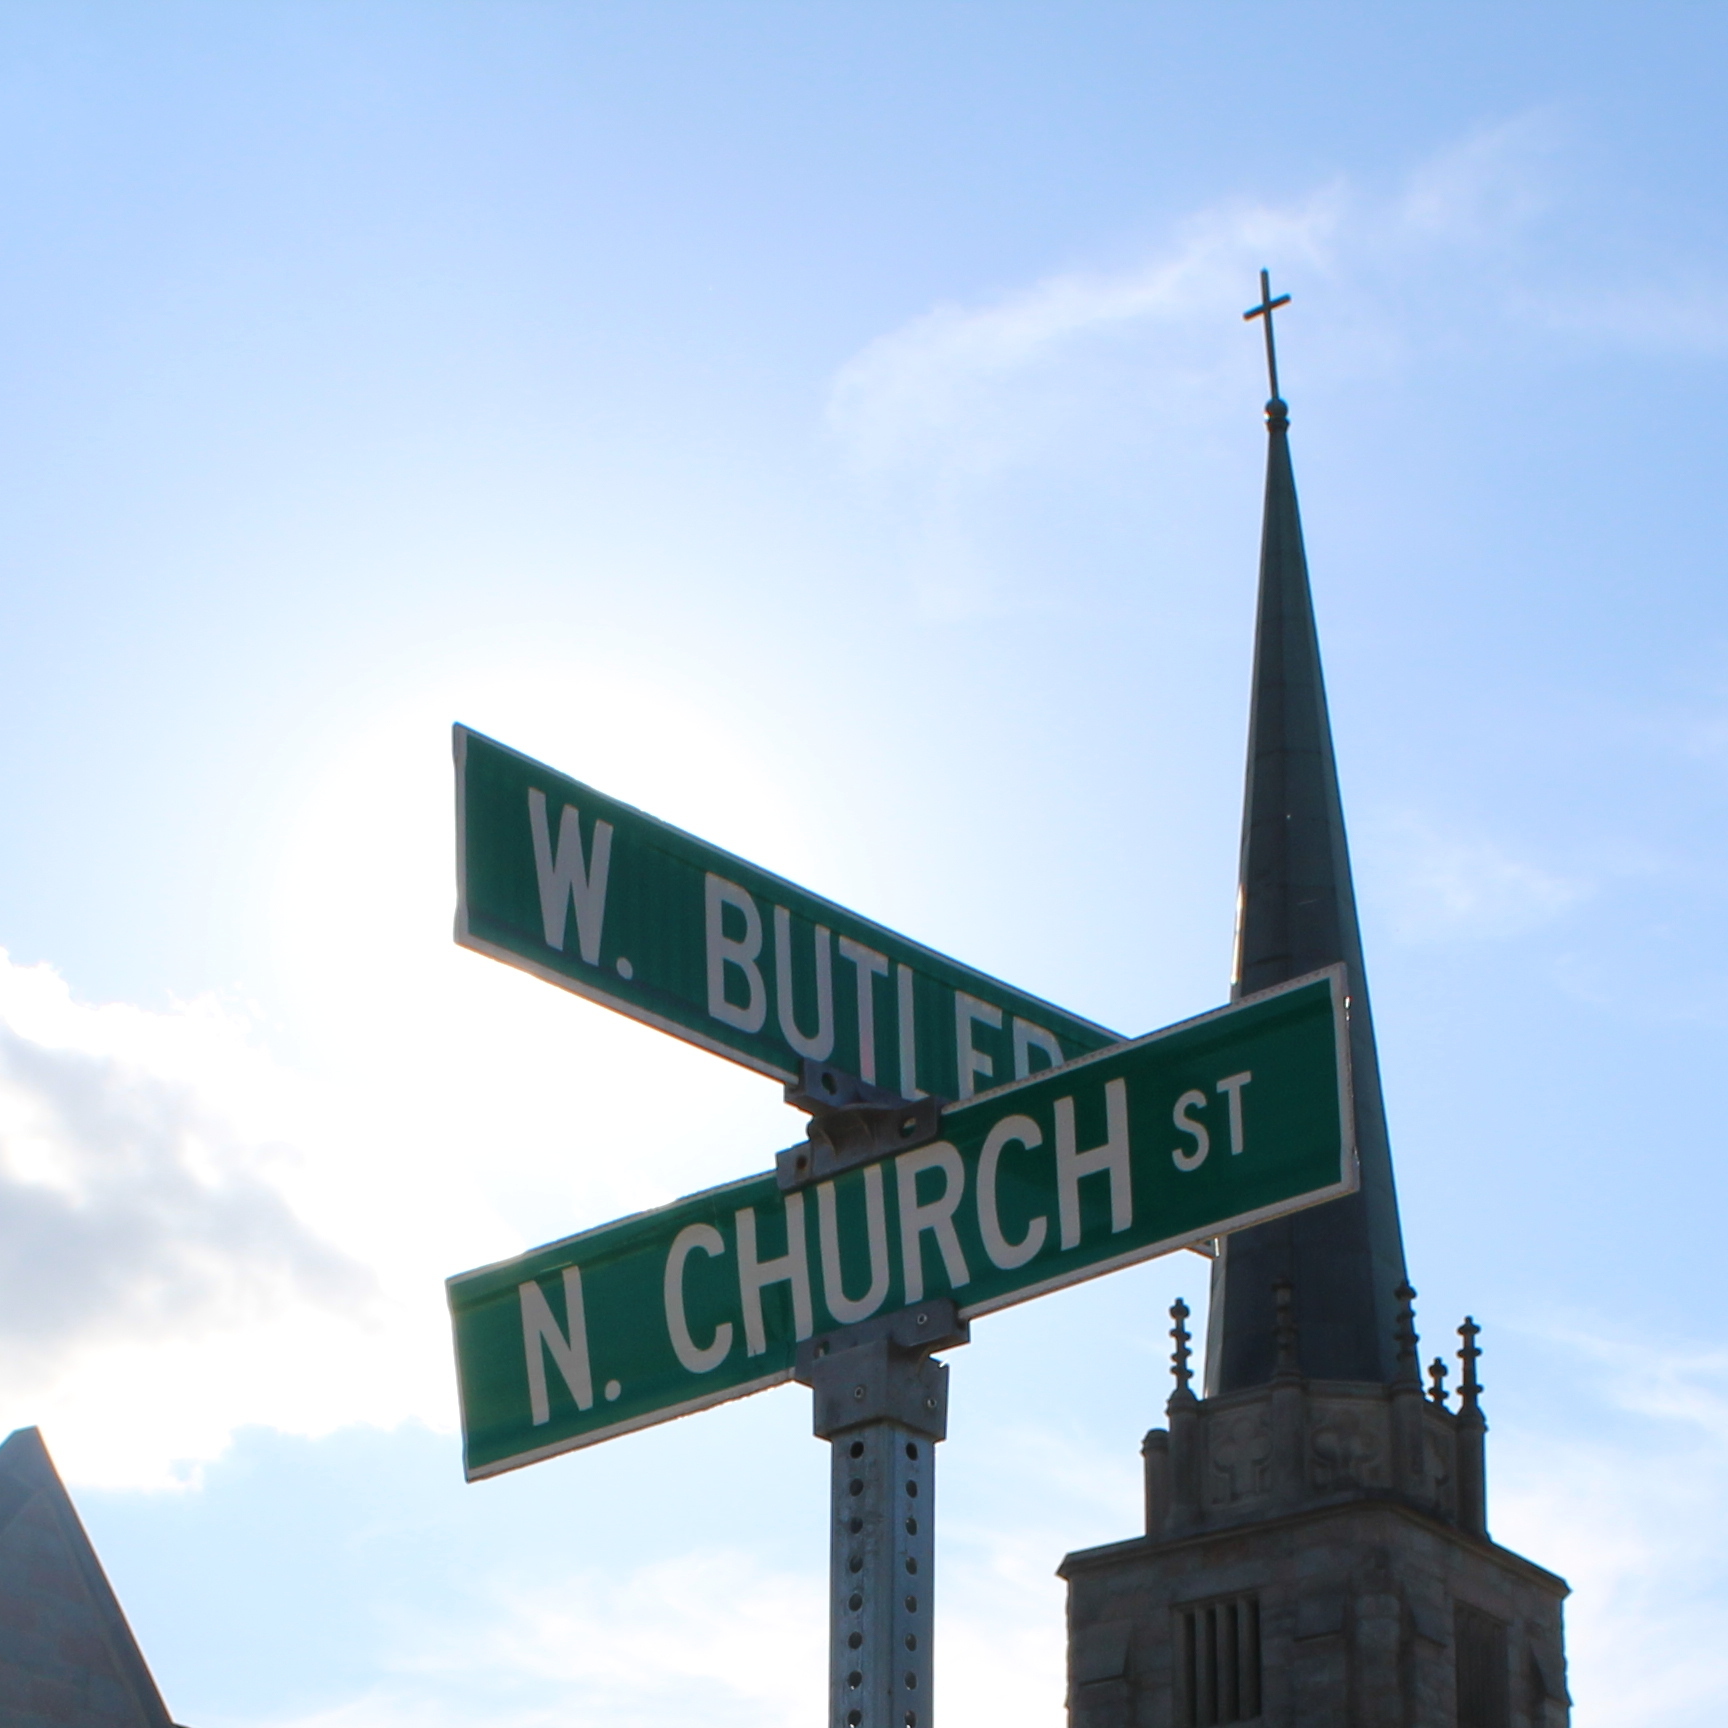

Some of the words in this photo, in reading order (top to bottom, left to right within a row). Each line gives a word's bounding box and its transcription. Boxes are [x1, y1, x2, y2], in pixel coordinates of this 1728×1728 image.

[527, 787, 635, 980] W.
[519, 1266, 622, 1427] N.
[663, 1077, 1134, 1374] CHURCH
[1170, 1070, 1252, 1173] ST
